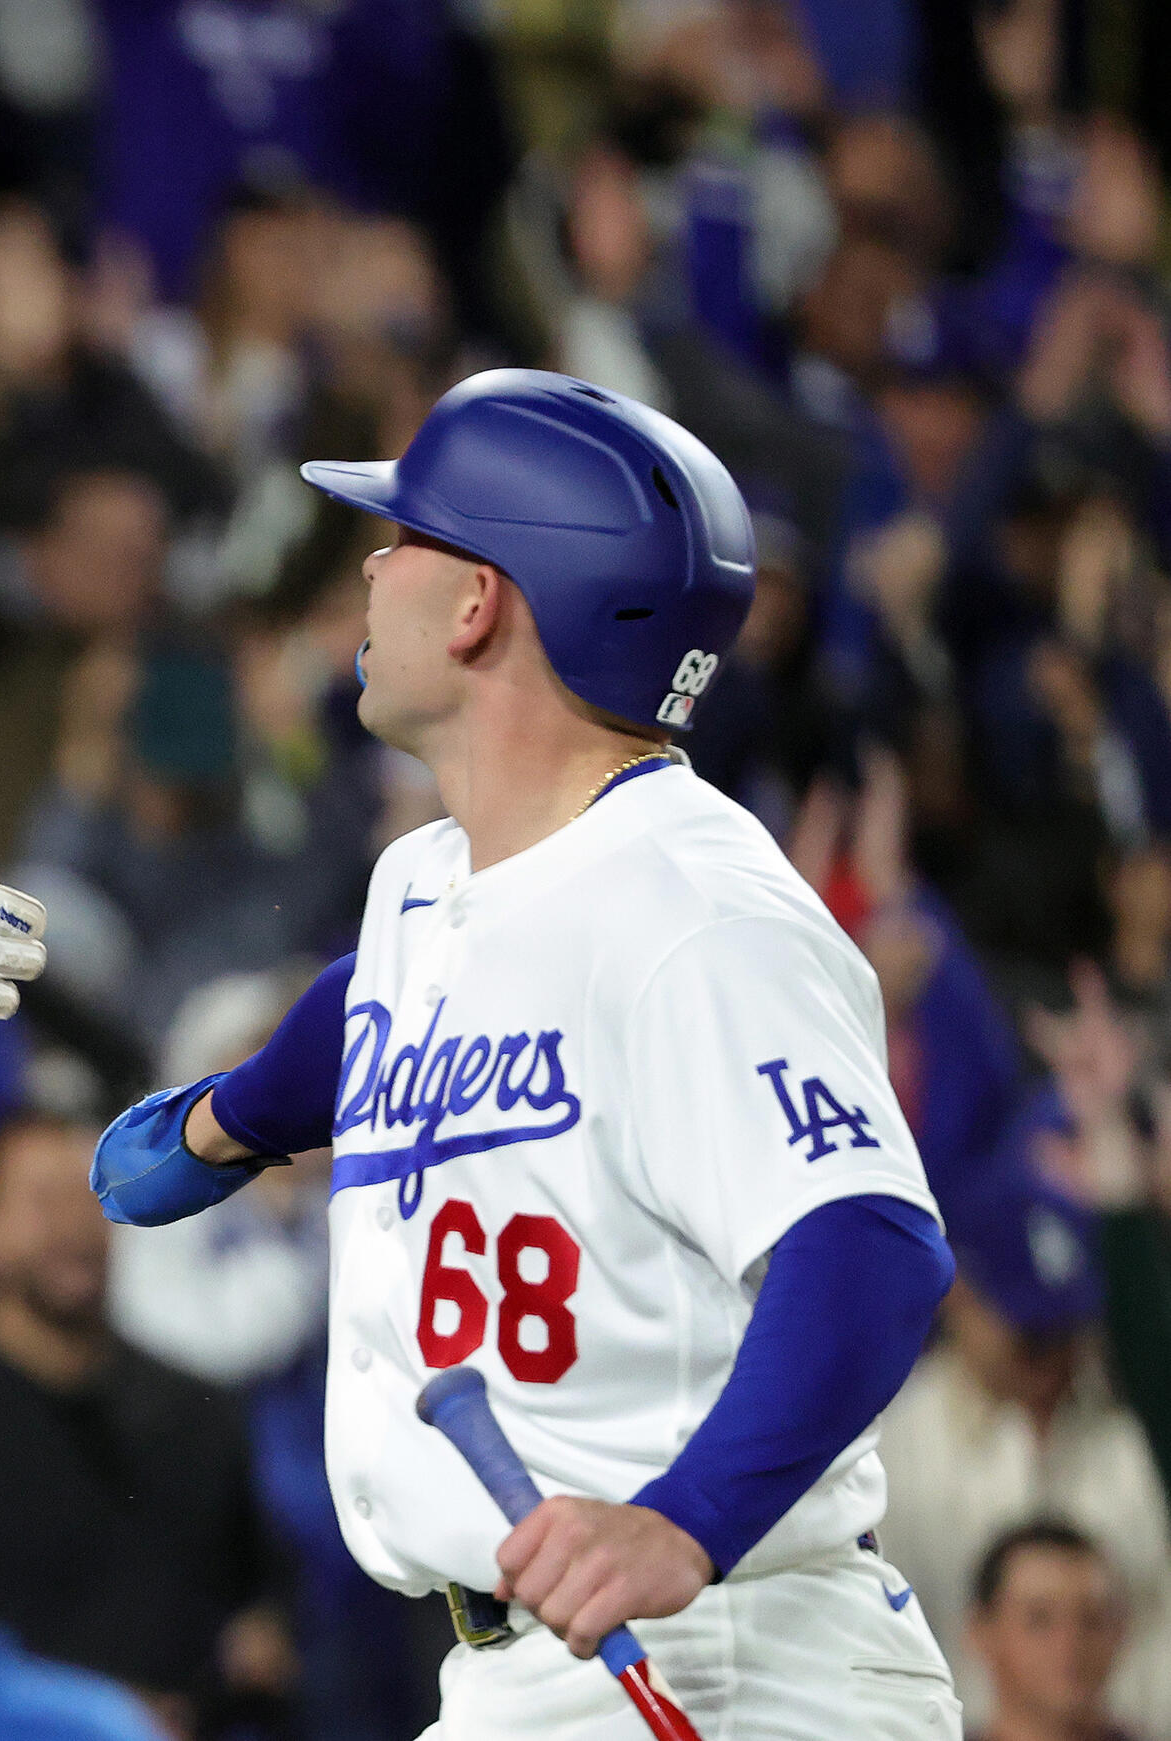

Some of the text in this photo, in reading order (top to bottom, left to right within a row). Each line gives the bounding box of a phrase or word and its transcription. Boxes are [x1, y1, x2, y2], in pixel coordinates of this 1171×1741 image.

[672, 648, 719, 697] 68
[331, 995, 581, 1221] Ddgers
[756, 1058, 880, 1163] LA
[417, 1197, 581, 1385] 68
